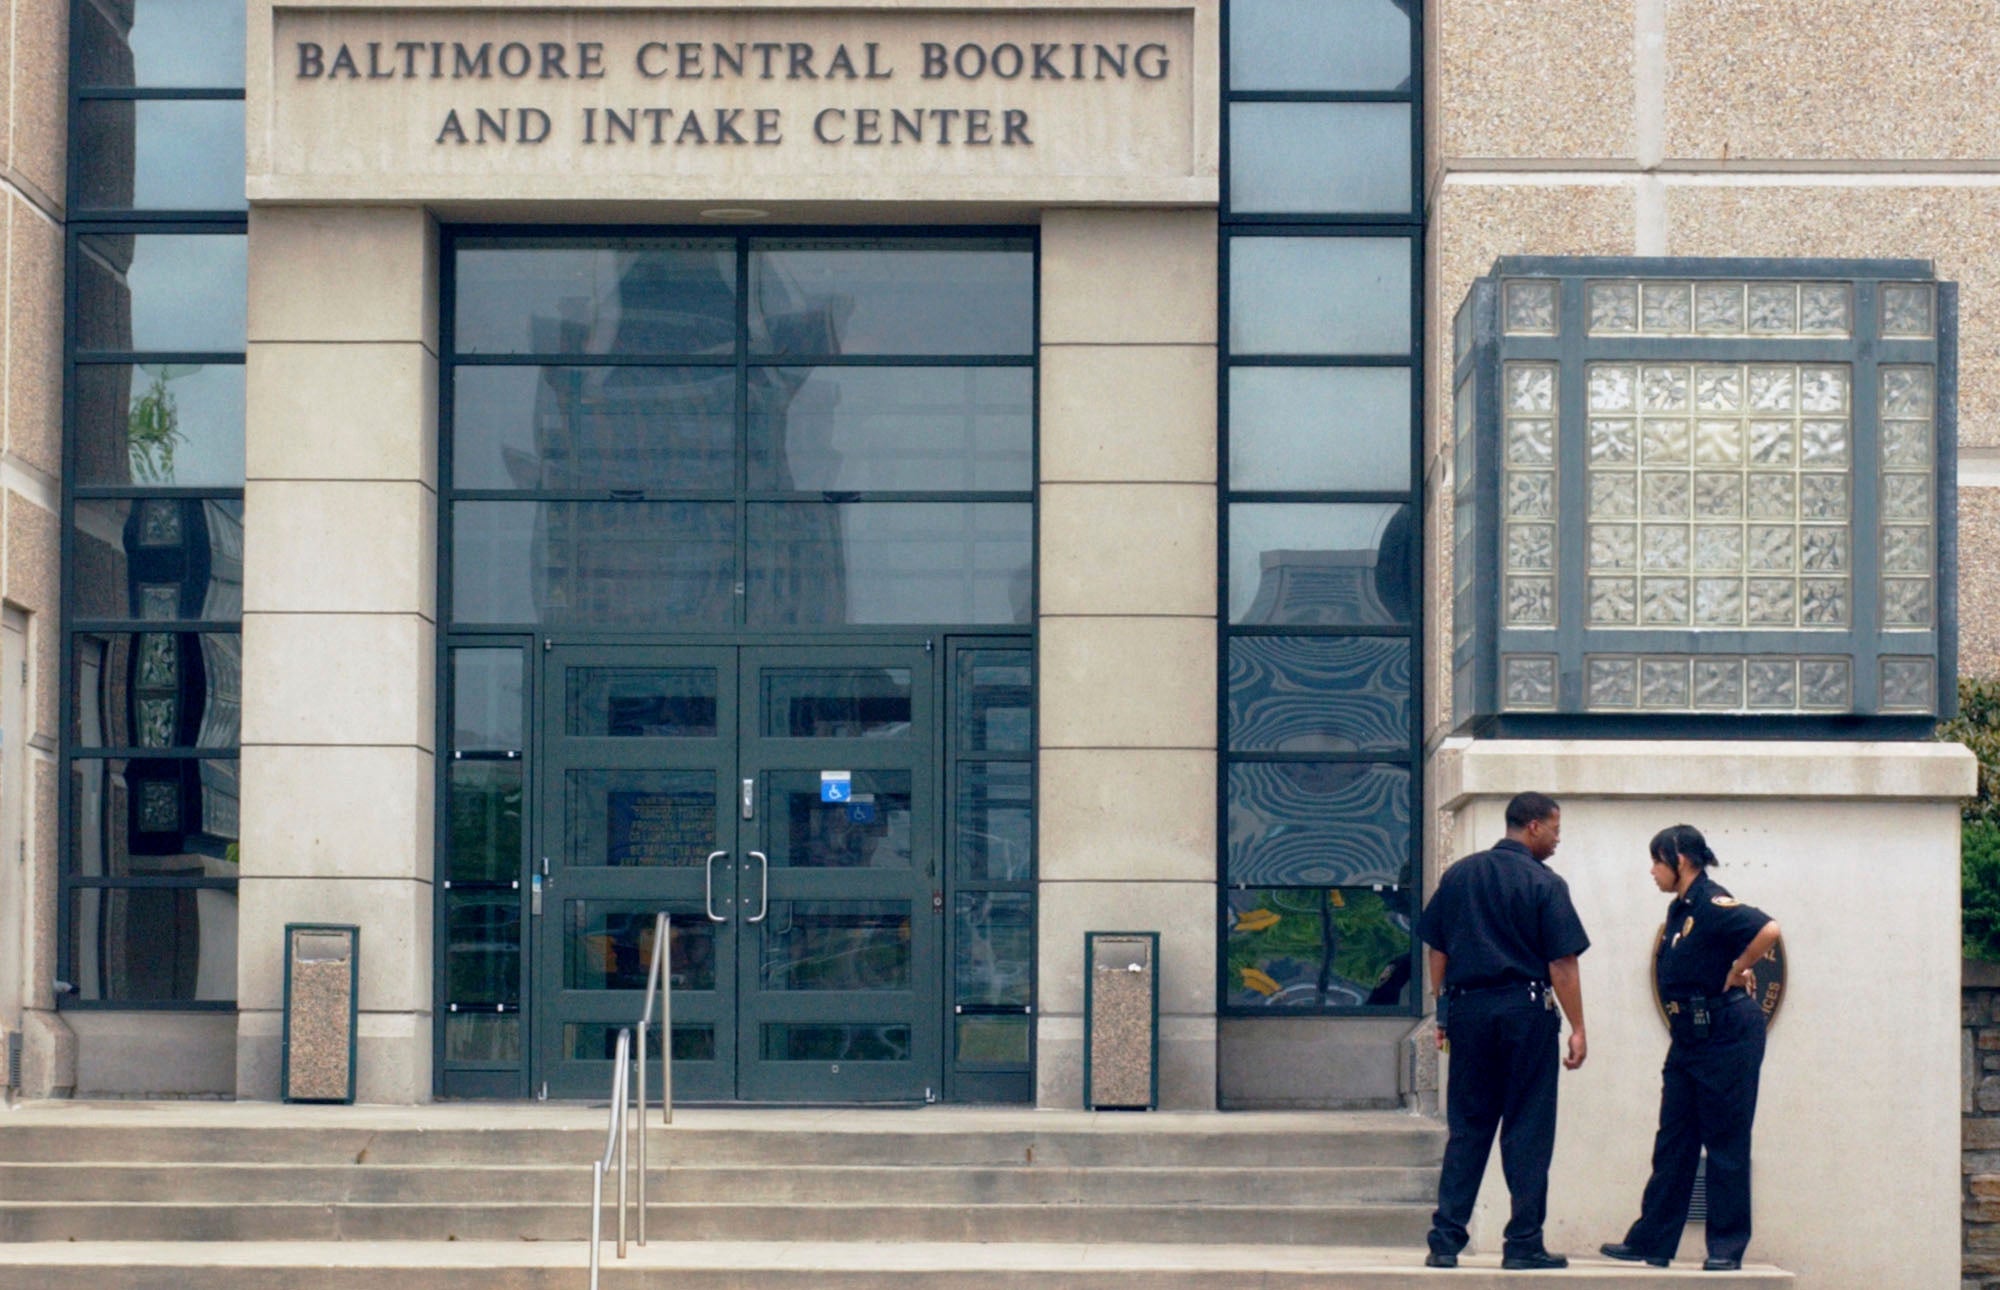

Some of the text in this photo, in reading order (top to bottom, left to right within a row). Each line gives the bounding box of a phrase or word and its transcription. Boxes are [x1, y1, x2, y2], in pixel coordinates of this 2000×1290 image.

[297, 41, 1169, 80] BALTIMORE CENTRAL BOOKING
[437, 108, 1031, 144] AND INTAKE CENTER
[1761, 981, 1781, 1015] ICES
